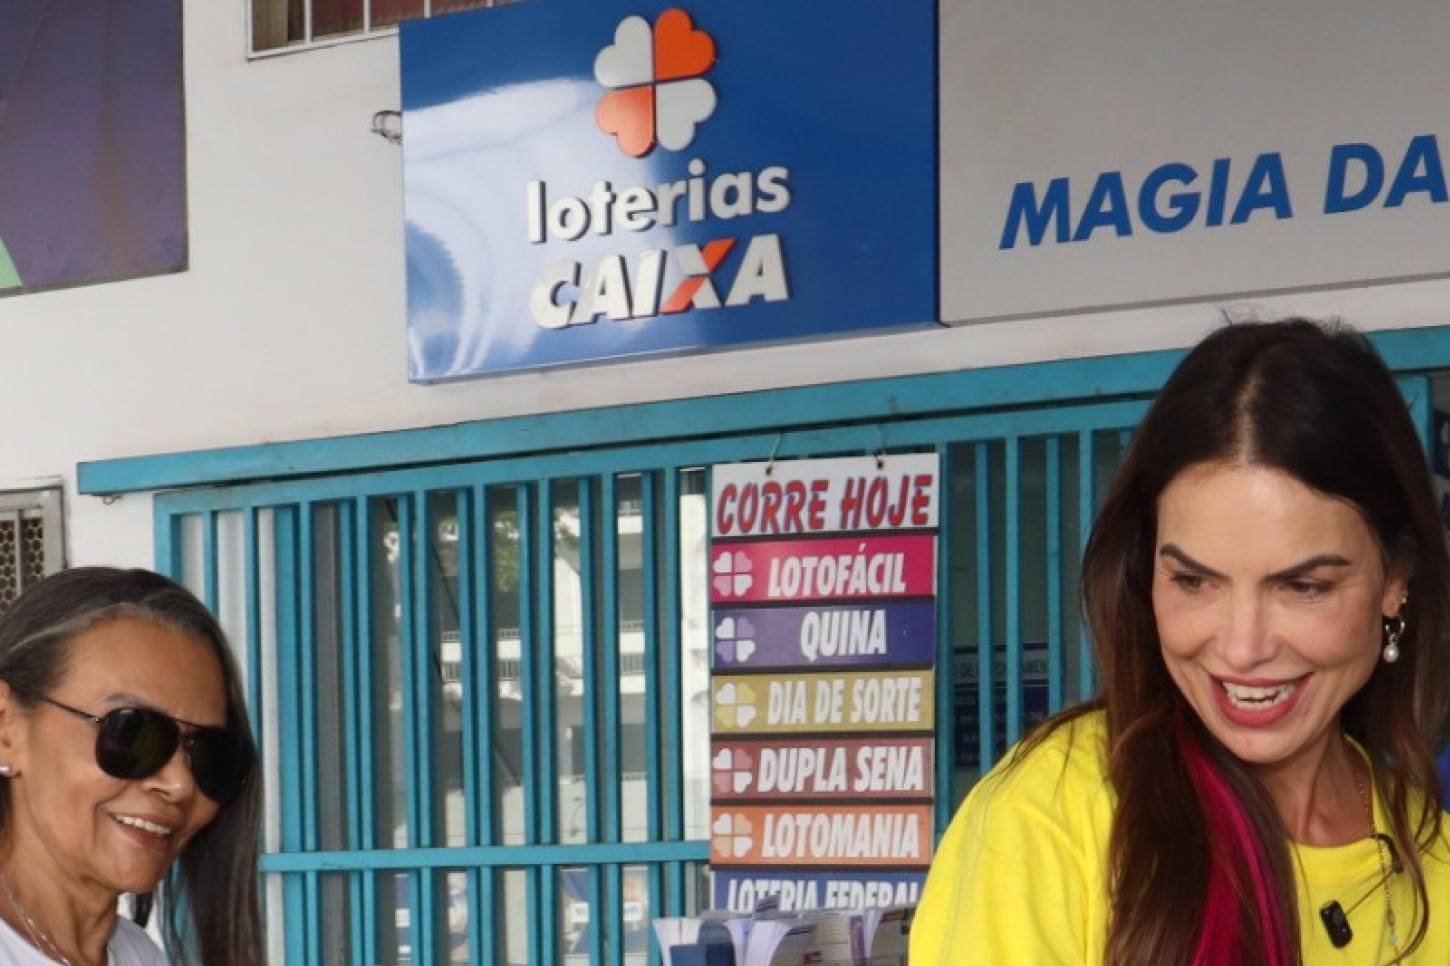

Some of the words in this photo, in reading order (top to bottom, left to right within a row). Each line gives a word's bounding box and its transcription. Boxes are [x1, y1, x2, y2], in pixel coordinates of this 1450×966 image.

[527, 158, 791, 244] loterias
[1000, 152, 1292, 250] MAGIA
[1324, 133, 1449, 215] DA
[529, 233, 791, 329] CAIXA
[717, 479, 829, 534] CORRE
[840, 474, 933, 530] HOJE
[768, 543, 906, 598] LOTOFÁCIL
[801, 610, 887, 662] QUINA
[767, 680, 806, 725] DIA
[814, 679, 845, 724] DE
[851, 677, 922, 723] SORTE
[757, 747, 848, 792] DUPLA
[854, 746, 924, 791] SENA
[762, 813, 920, 858] LOTOMANIA
